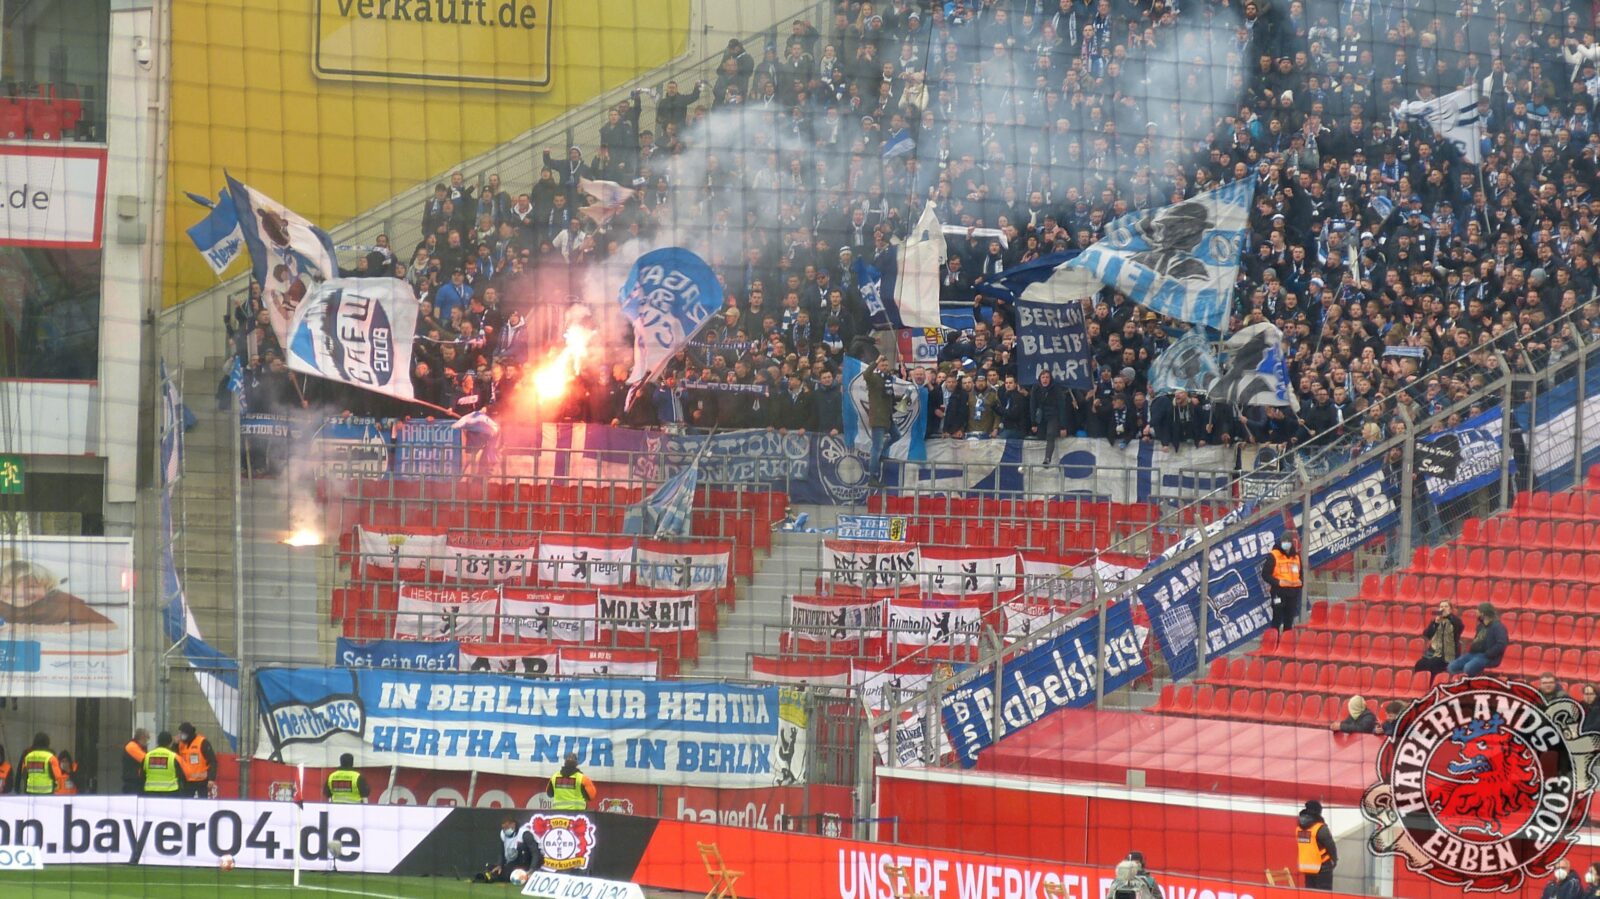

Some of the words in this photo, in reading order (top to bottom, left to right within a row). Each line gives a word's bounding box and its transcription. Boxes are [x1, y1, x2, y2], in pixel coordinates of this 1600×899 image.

[337, 0, 536, 29] verkauft.de
[1017, 305, 1083, 328] BERLIN
[372, 327, 390, 373] 2008
[1036, 359, 1089, 381] HART
[1154, 560, 1202, 611] FAN
[1208, 530, 1276, 572] CLUB
[410, 589, 458, 603] HERTHA
[343, 651, 372, 667] Sei
[416, 654, 456, 671] Teil
[378, 682, 420, 709] IN
[426, 684, 559, 717] BERLIN
[567, 688, 646, 720] NUR
[657, 690, 770, 724] HERTHA
[973, 629, 1143, 742] Babelsberg
[329, 699, 360, 730] BSC
[372, 725, 520, 761] HERTHA
[530, 734, 614, 767] NUR
[625, 738, 668, 770] IN
[676, 740, 771, 774] BERLIN
[838, 849, 949, 899] UNSERE
